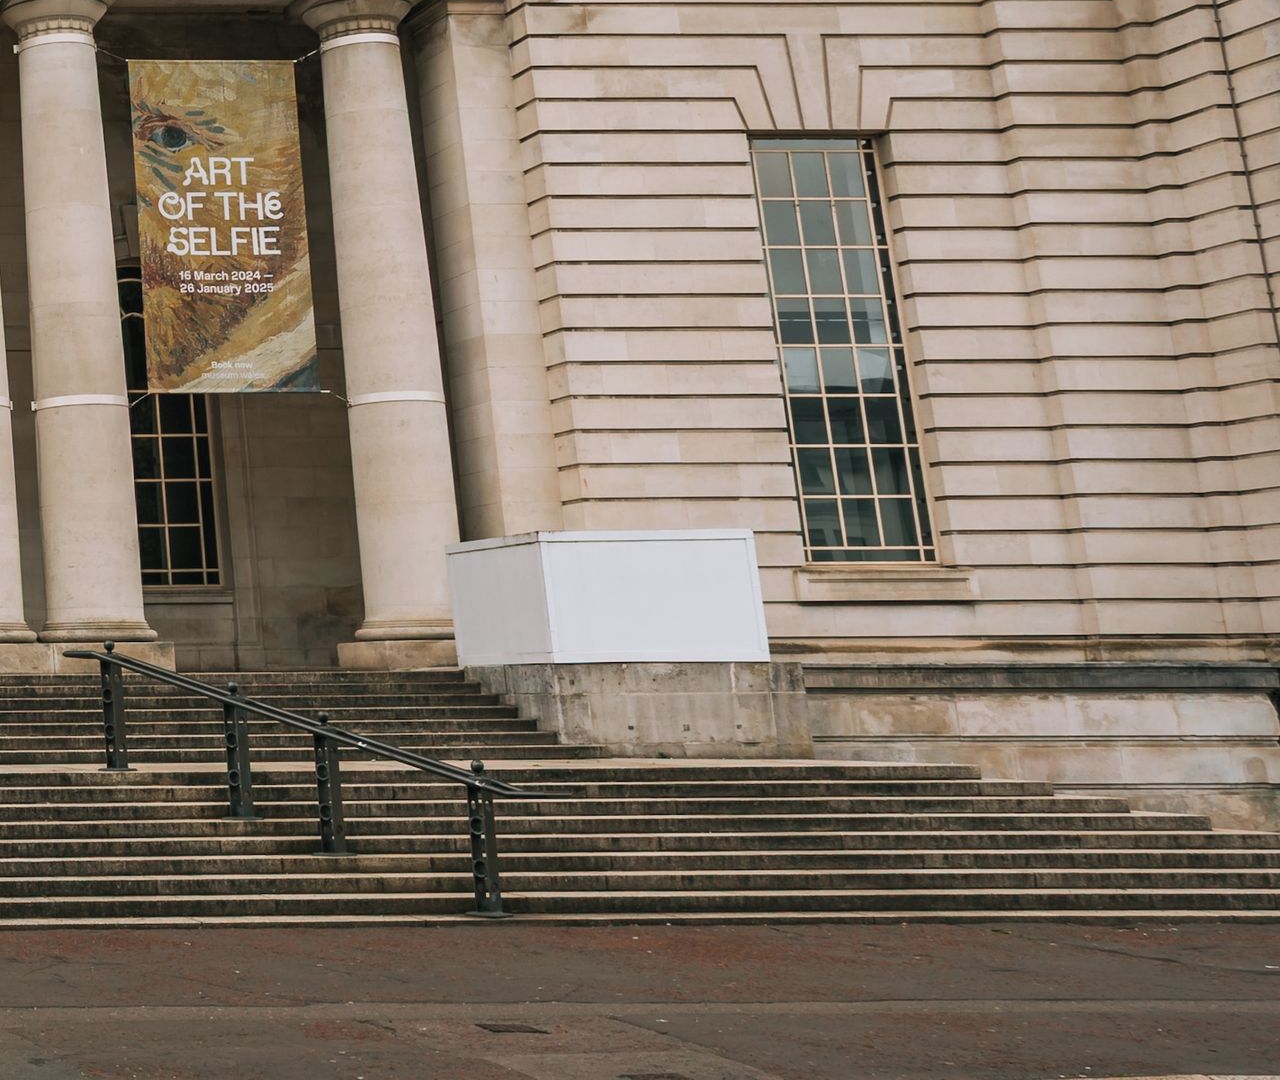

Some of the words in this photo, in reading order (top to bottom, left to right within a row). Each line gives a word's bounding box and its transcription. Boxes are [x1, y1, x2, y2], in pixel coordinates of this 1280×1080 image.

[182, 157, 254, 186] ART
[157, 191, 207, 221] OF
[214, 191, 285, 221] THE
[166, 226, 282, 256] SELFIE
[178, 271, 192, 281] 16
[194, 270, 229, 281] March
[231, 271, 261, 281] 2024
[180, 283, 195, 293] 26
[196, 283, 242, 295] January
[244, 282, 274, 293] 2025
[211, 361, 233, 369] Book
